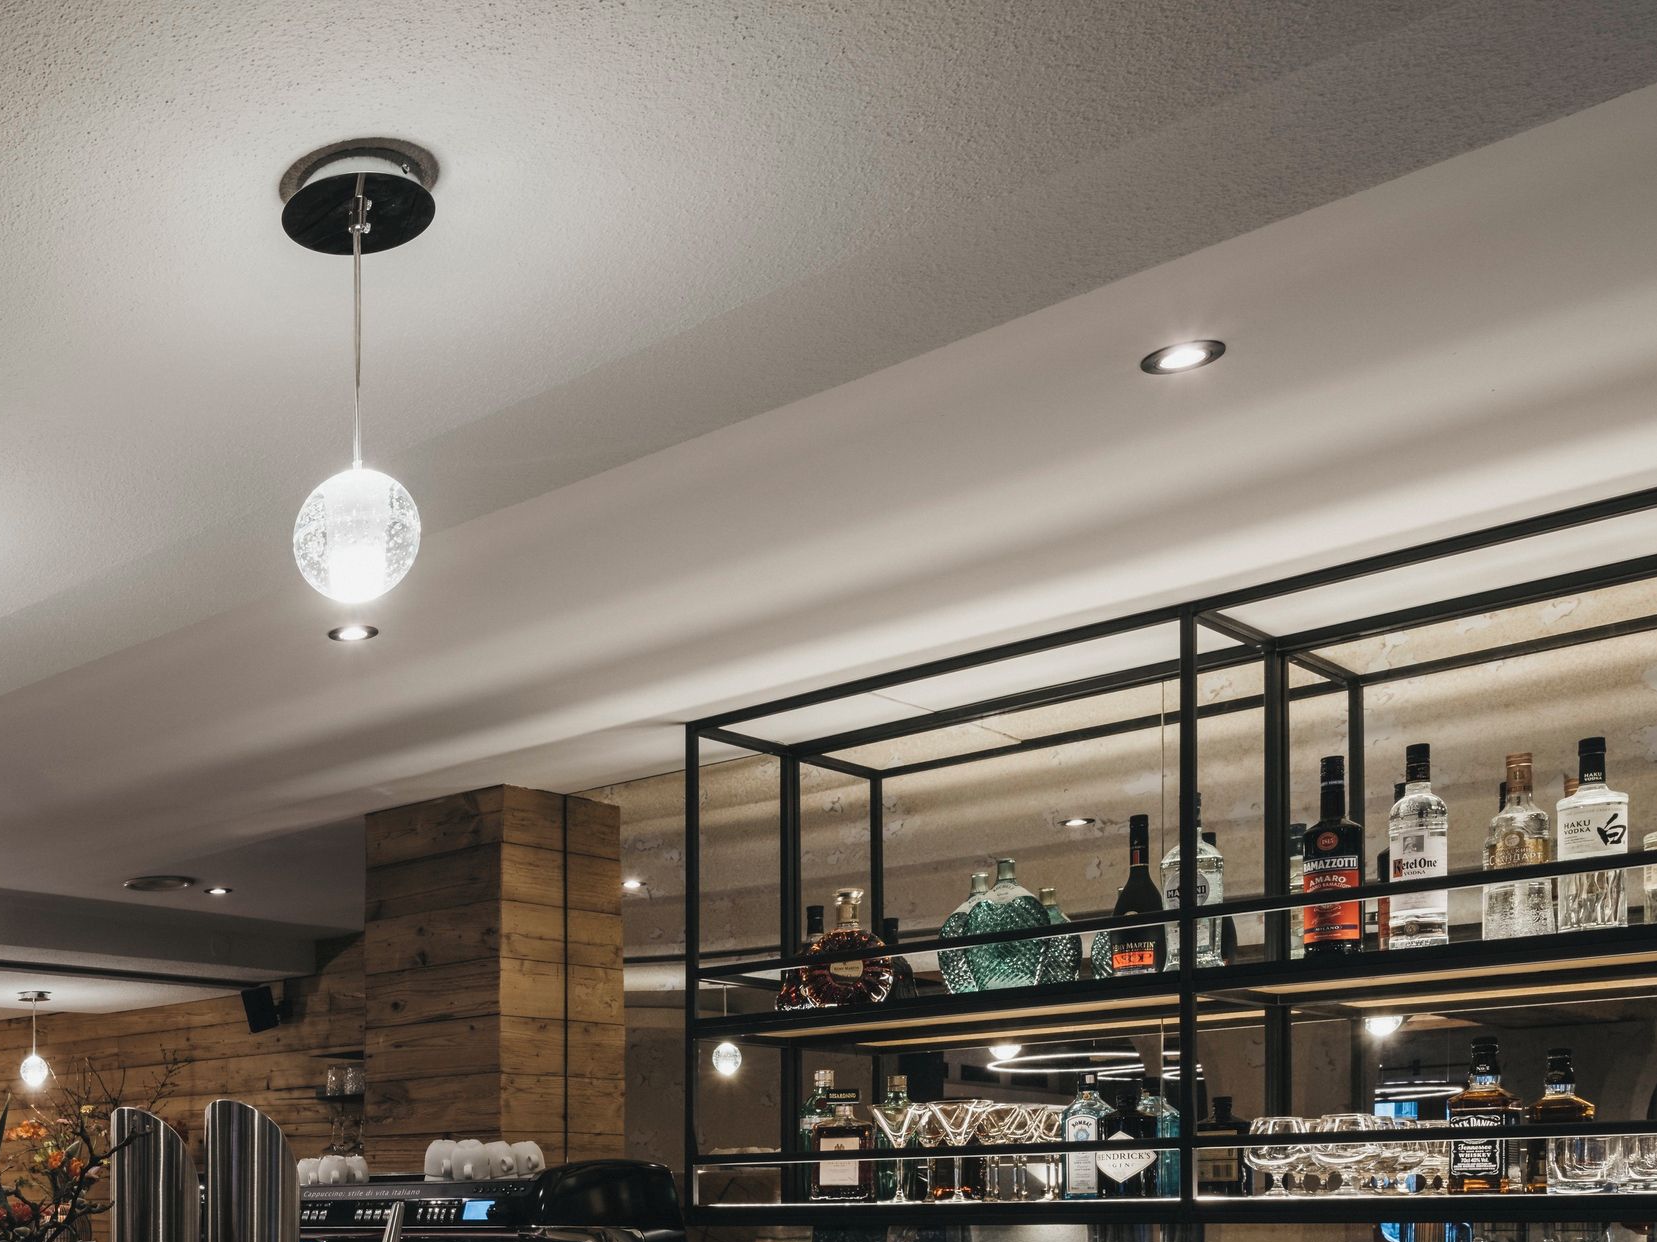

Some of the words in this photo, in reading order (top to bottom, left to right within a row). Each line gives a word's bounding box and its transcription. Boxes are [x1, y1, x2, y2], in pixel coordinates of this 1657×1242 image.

[1564, 819, 1591, 830] HAKU
[1564, 827, 1591, 835] VODKA
[1394, 859, 1417, 875] Ketel
[1419, 858, 1437, 869] One
[1309, 874, 1346, 887] AMARO
[1071, 1120, 1092, 1128] BOMBAY
